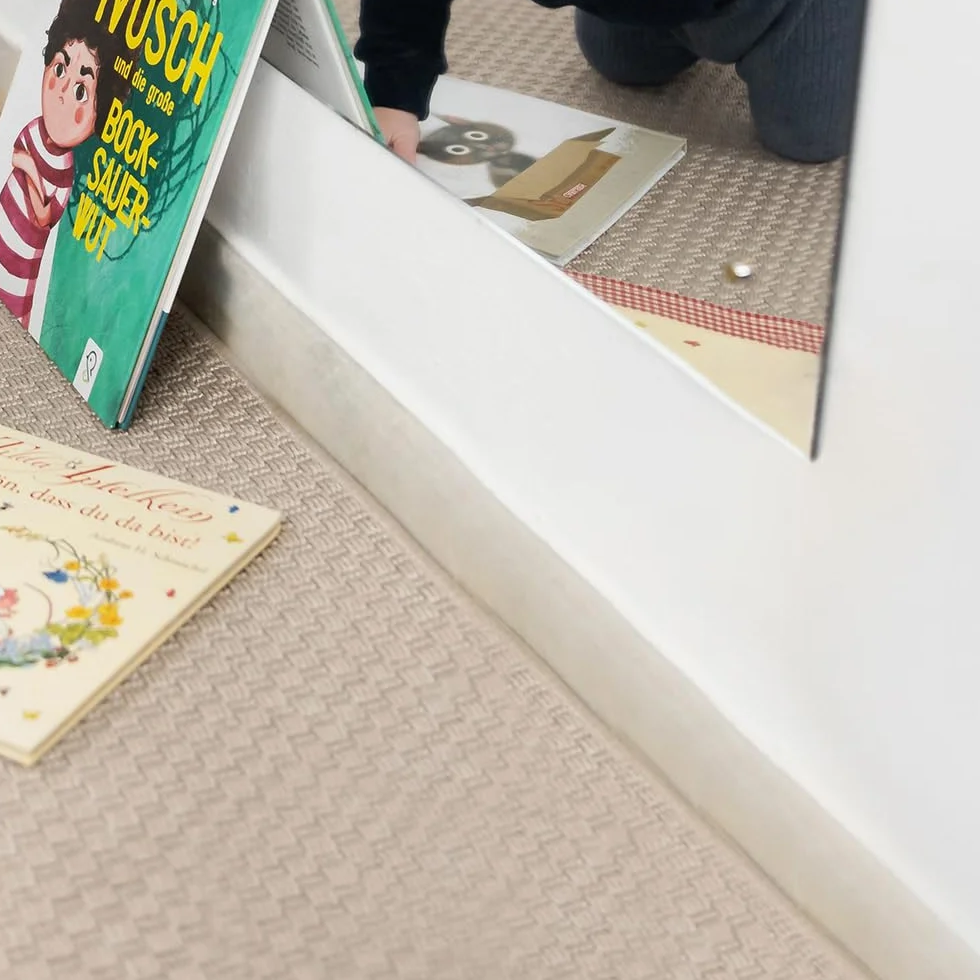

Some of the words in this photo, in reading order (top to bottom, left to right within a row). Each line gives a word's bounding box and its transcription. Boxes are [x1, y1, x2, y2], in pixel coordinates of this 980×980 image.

[113, 55, 134, 80] und
[131, 67, 148, 93] die
[145, 83, 176, 117] große
[101, 97, 160, 177] BOCK-
[86, 147, 151, 236] SAUER-
[72, 192, 118, 263] WUT
[29, 487, 73, 509] dass
[79, 504, 110, 522] du
[114, 515, 143, 533] da
